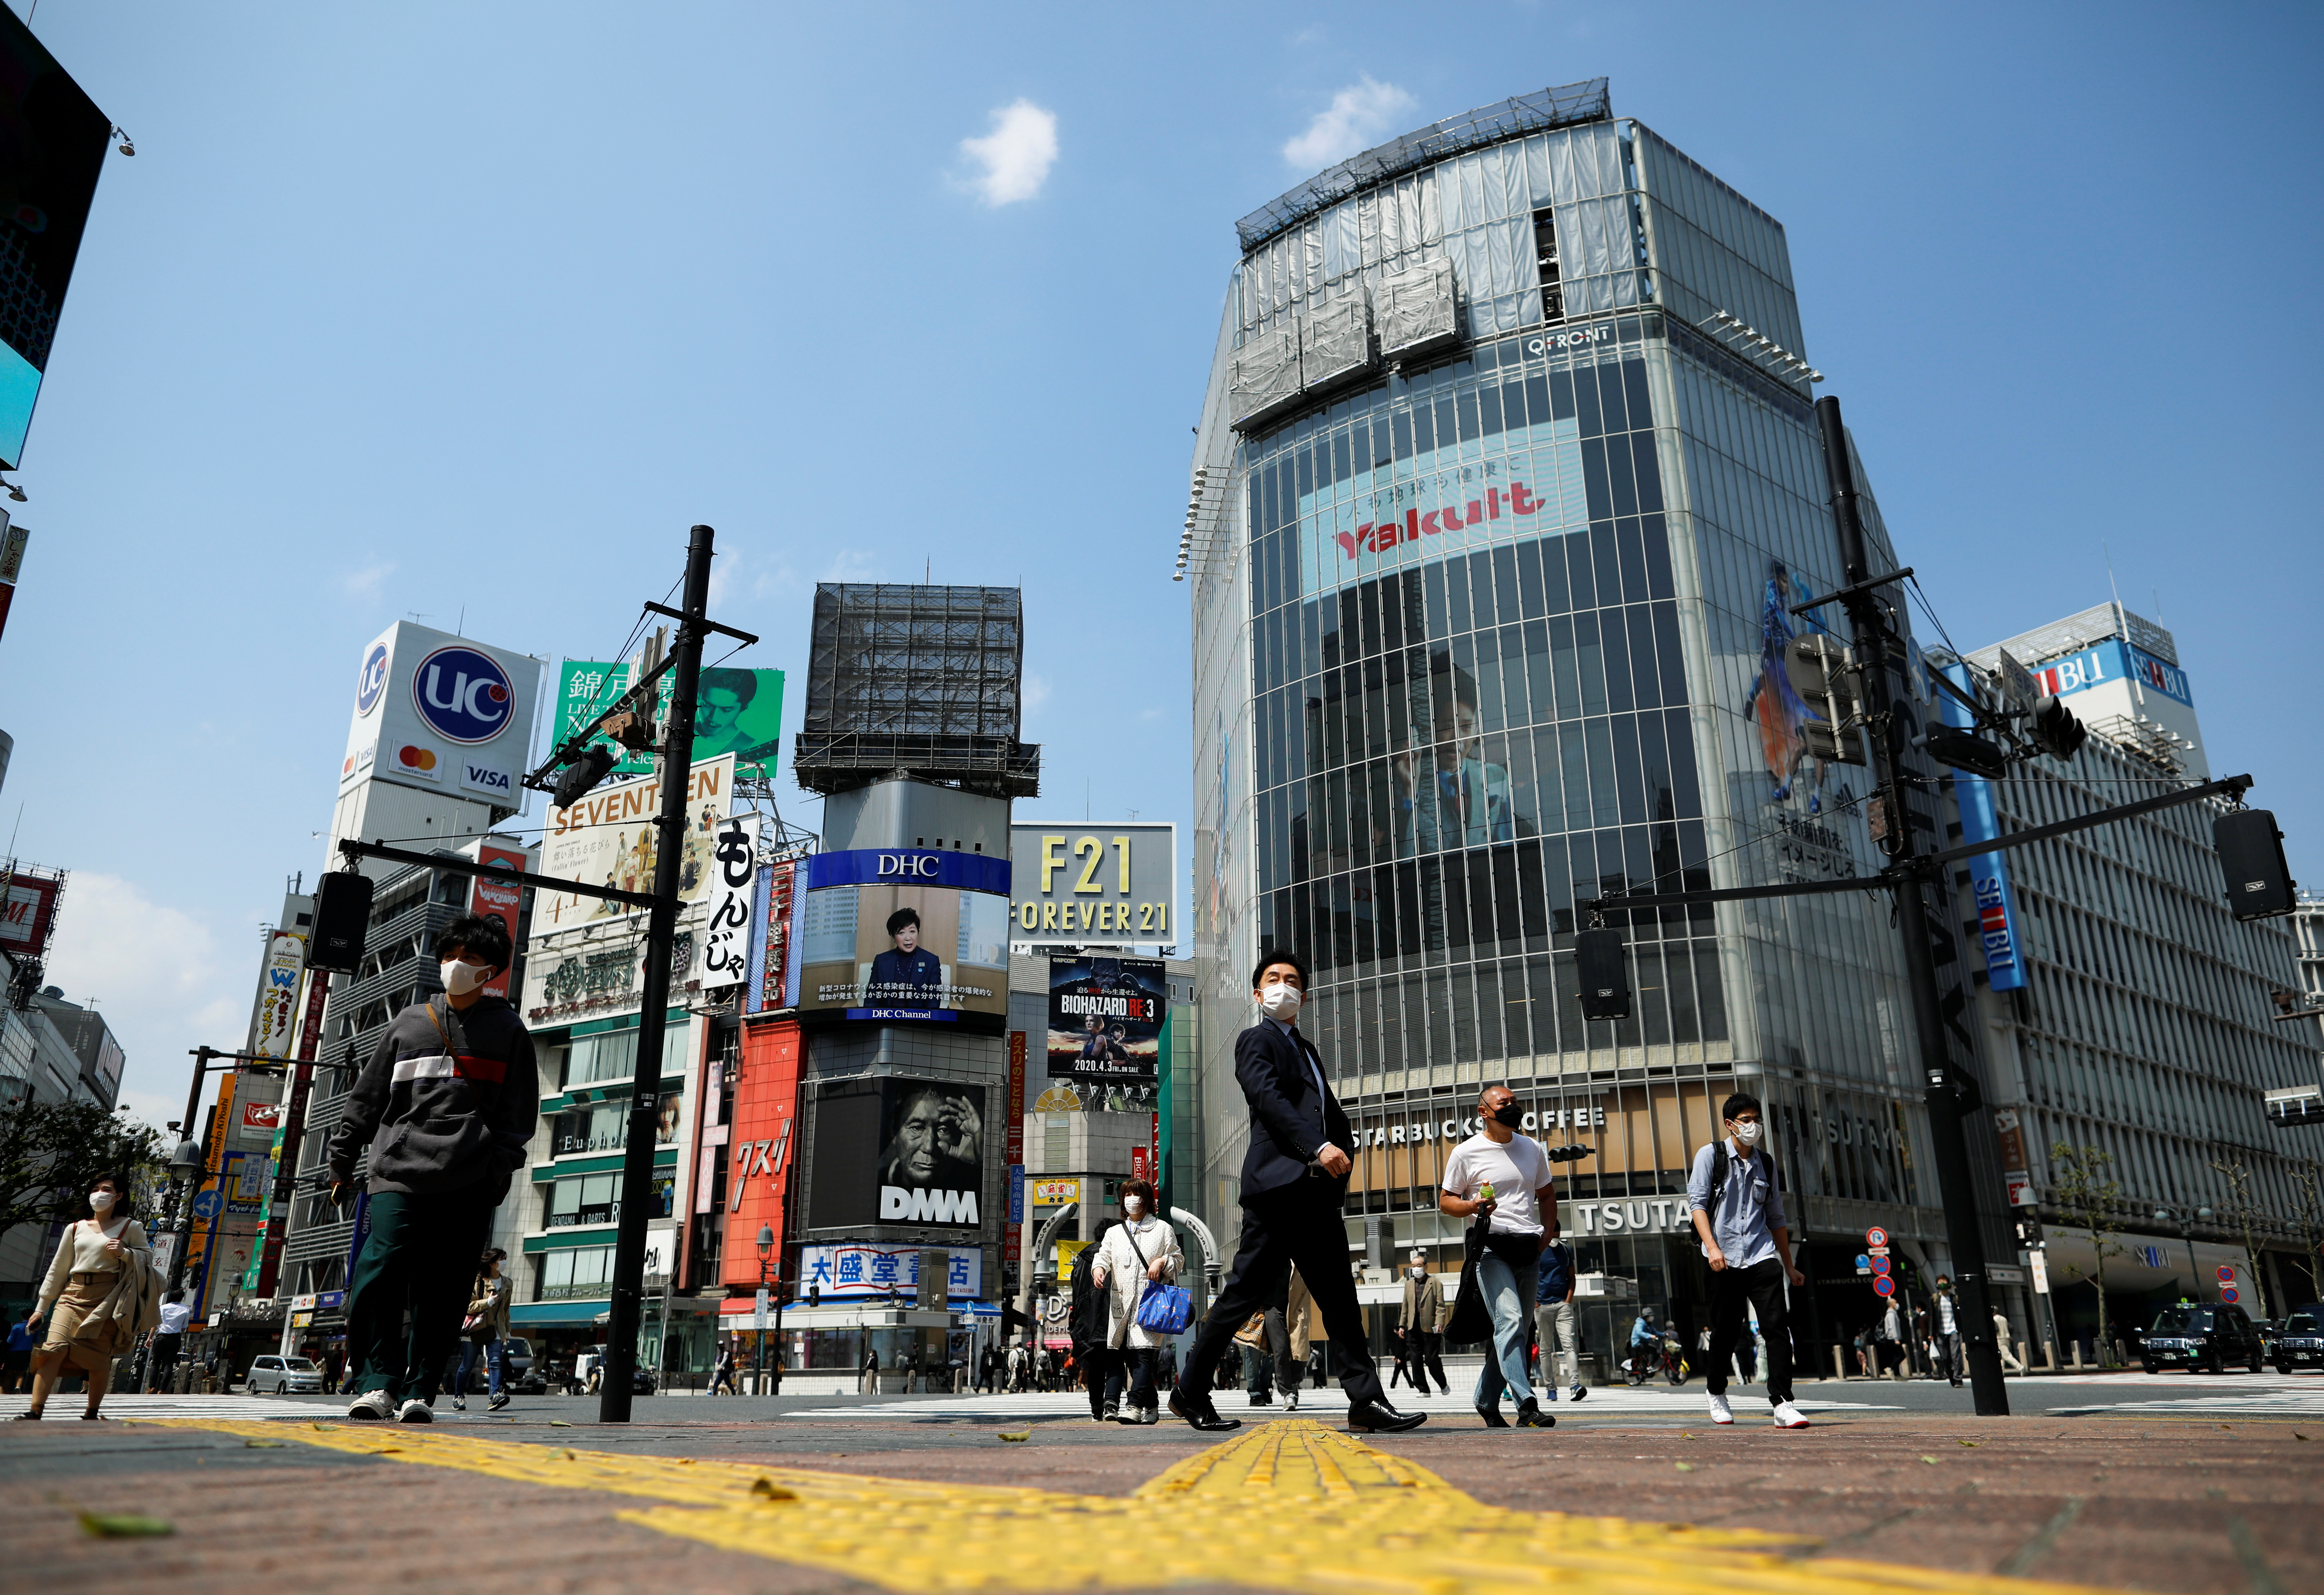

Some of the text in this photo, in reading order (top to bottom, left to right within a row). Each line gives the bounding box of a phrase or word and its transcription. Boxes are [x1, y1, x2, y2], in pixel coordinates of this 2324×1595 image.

[1332, 482, 1546, 560] Yakult
[426, 664, 503, 721] UC
[398, 766, 433, 778] mastercard
[467, 765, 509, 790] VISA
[553, 767, 720, 836] SEVENTEN
[876, 854, 939, 877] DHC
[1041, 835, 1129, 893] F21
[478, 885, 519, 905] VANGUARD
[706, 819, 754, 980] もんじゃ
[1139, 903, 1166, 930] 21
[1975, 876, 2015, 970] SEIBU
[761, 866, 789, 1002] 三千里薬品
[818, 991, 965, 1002] 増加が発生するか否かの重要な分かれ目です
[1061, 994, 1127, 1016] BIOHAZARD
[1076, 986, 1138, 997] 迫る絶望から生還せよ。
[872, 1009, 931, 1019] DHC Channel
[1011, 1035, 1023, 1119] クスリのことなら
[1075, 1059, 1113, 1072] 2020.4.3
[563, 1130, 627, 1152] Euphor
[1351, 1107, 1604, 1148] STARBUCKS OFFEE
[1813, 1116, 1903, 1150] TSUTAYA
[246, 1157, 260, 1194] 渋谷駅前
[262, 1159, 273, 1194] スクランブル式
[1048, 1184, 1065, 1194] 麻雀
[880, 1185, 979, 1224] DMM
[1012, 1167, 1022, 1220] 大盛堂商事ビル
[587, 1212, 606, 1224] DARTS
[1578, 1199, 1692, 1231] TSUTA
[153, 1238, 167, 1268] 道玄
